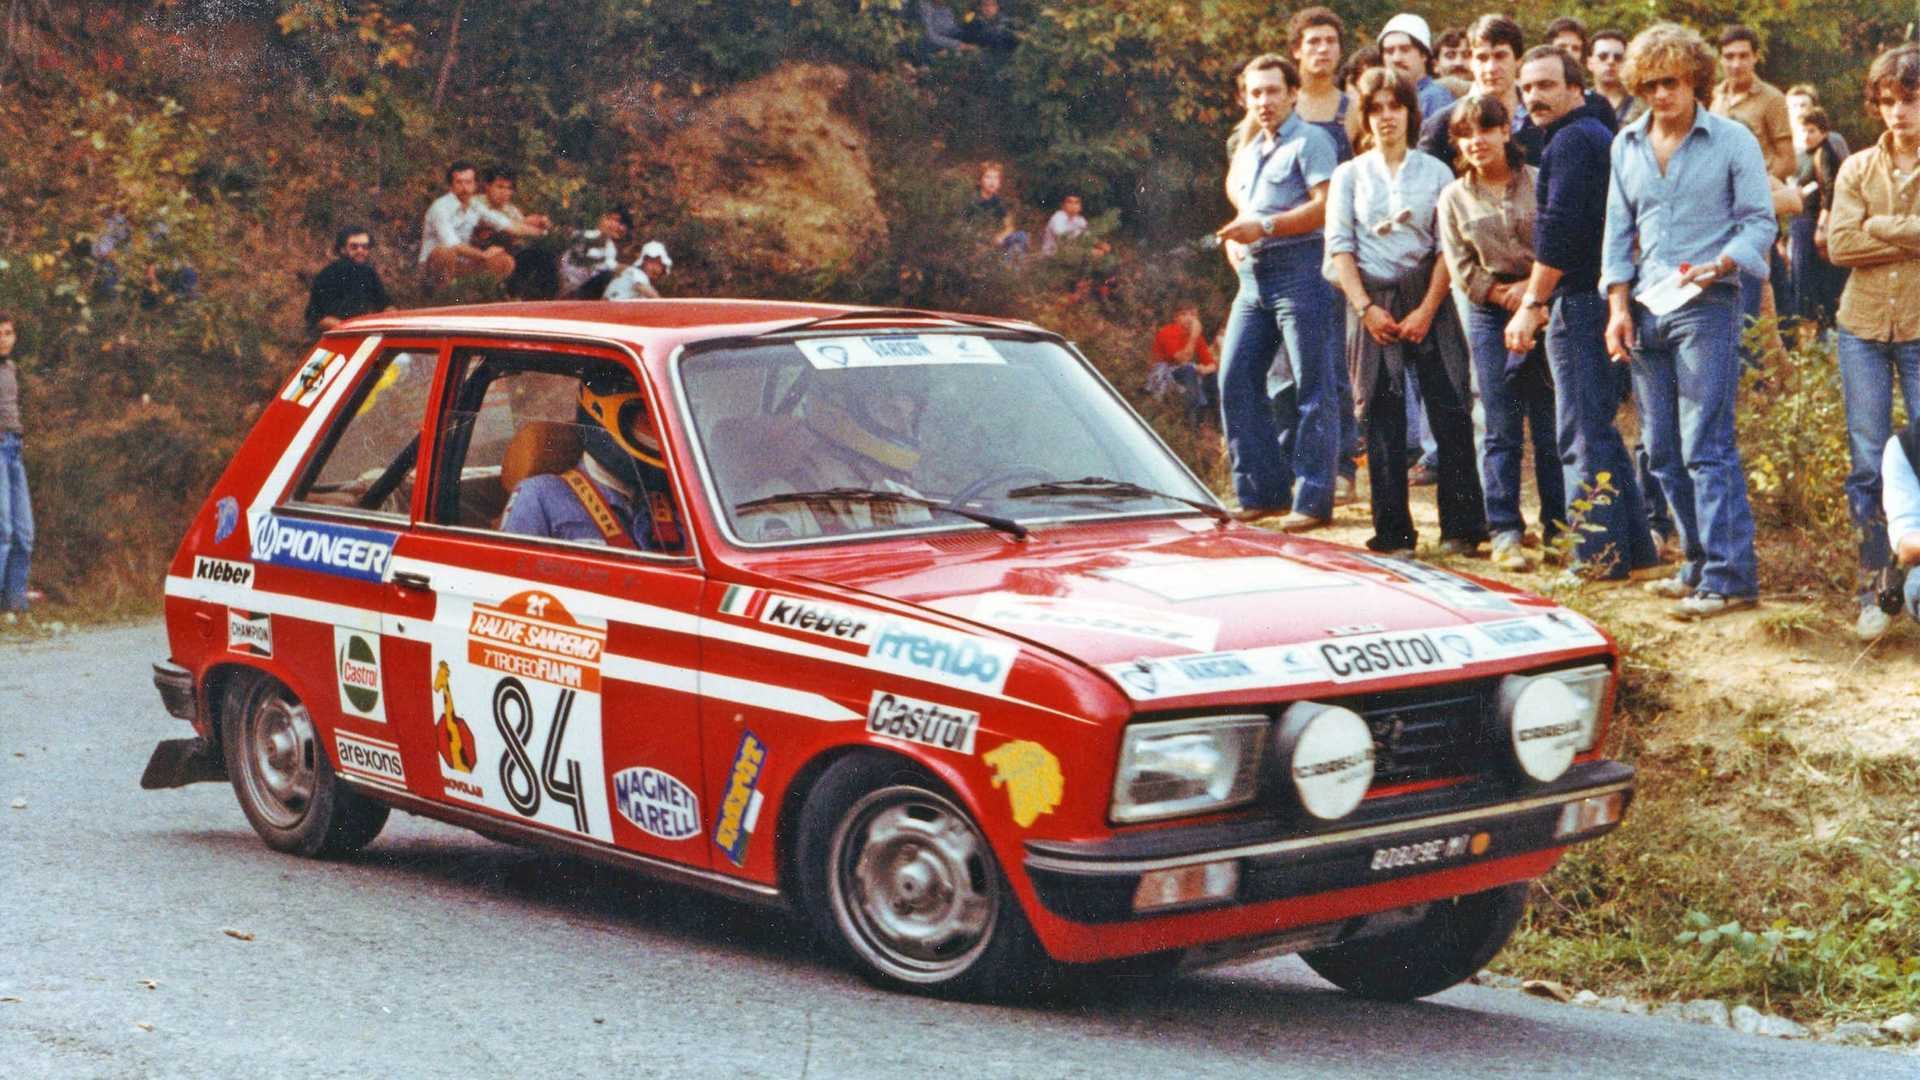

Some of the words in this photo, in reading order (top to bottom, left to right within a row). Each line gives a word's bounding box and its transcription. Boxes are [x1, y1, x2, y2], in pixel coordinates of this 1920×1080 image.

[274, 526, 388, 574] PIONEER
[231, 622, 268, 641] CHAMPION
[471, 614, 526, 645] RALLYE
[524, 625, 600, 660] SANREMO
[344, 661, 377, 686] Castrol
[1320, 633, 1443, 677] Castrol
[872, 694, 977, 751] Castrol
[339, 742, 402, 775] arexons
[493, 676, 590, 834] 84
